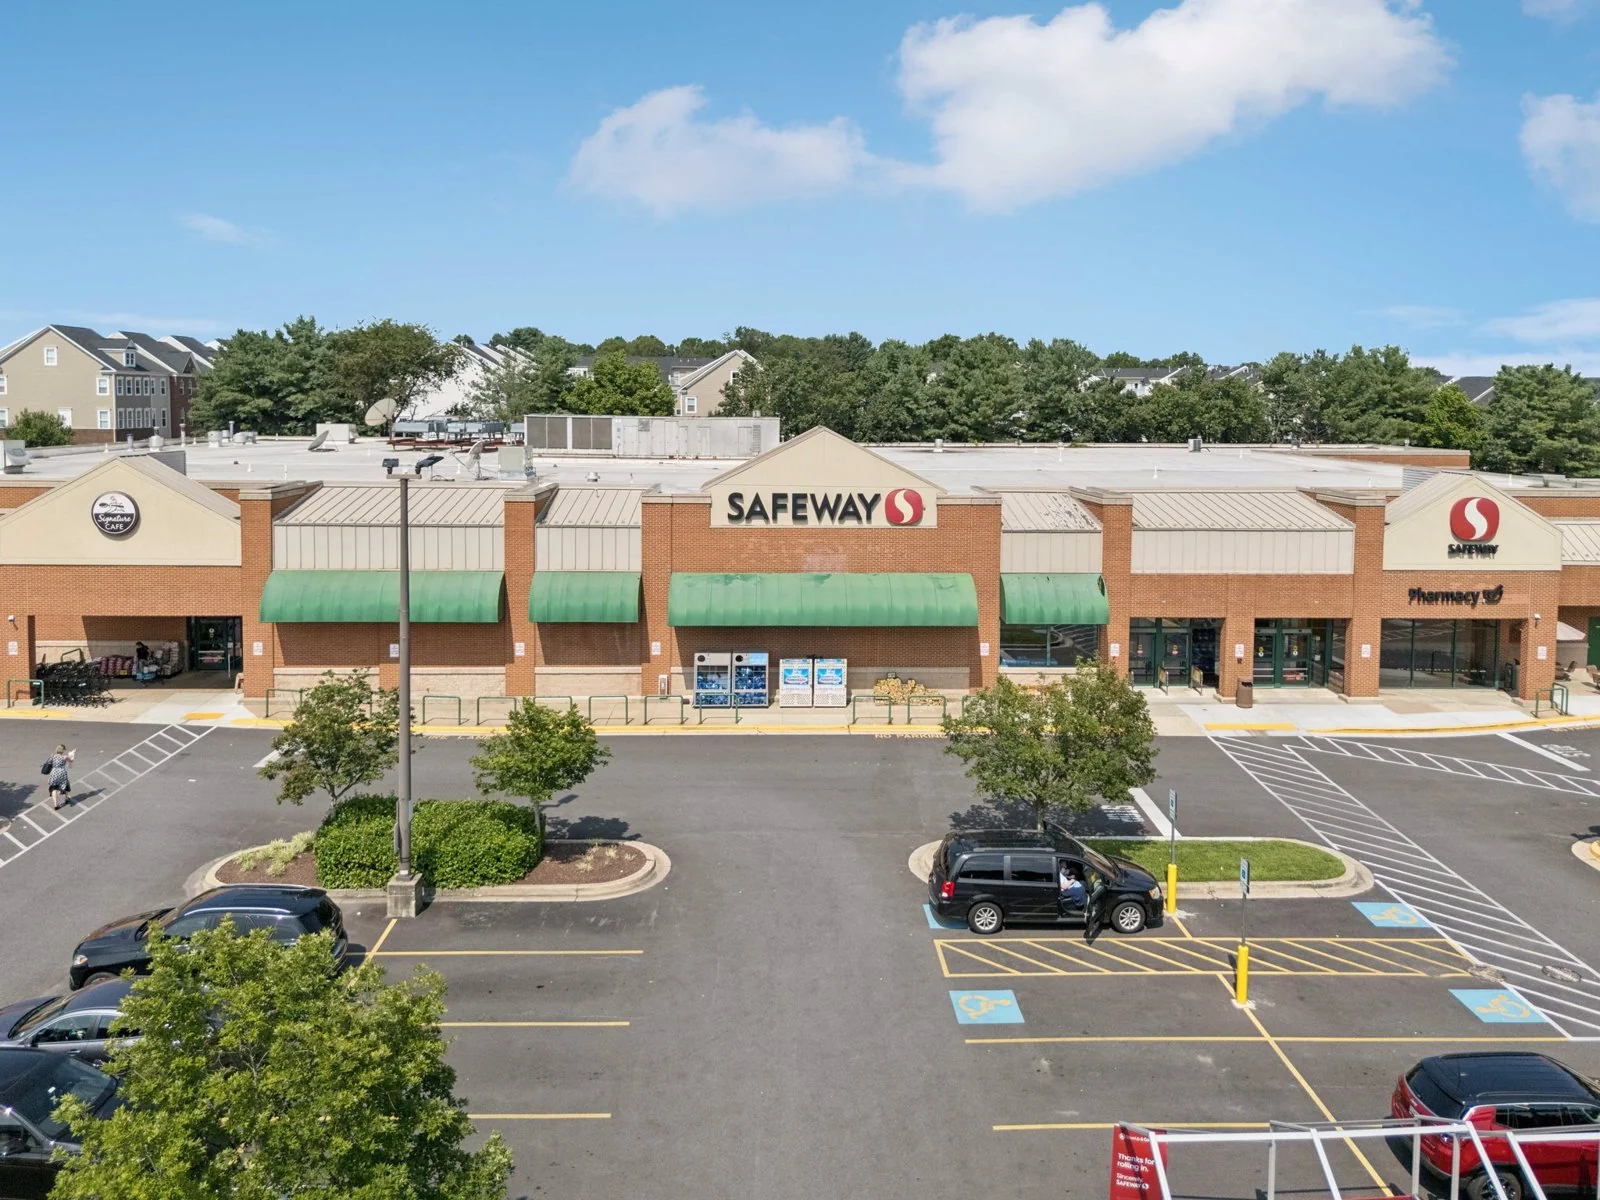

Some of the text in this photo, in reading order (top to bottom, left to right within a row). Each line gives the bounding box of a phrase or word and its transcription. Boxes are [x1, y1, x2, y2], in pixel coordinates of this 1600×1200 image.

[727, 492, 882, 523] SAFEWAY
[98, 514, 131, 524] Signature
[1448, 544, 1499, 554] SAFEWAY
[1408, 588, 1480, 608] Pharmacy
[1118, 1153, 1155, 1165] Thanks for
[1117, 1161, 1139, 1171] rolling
